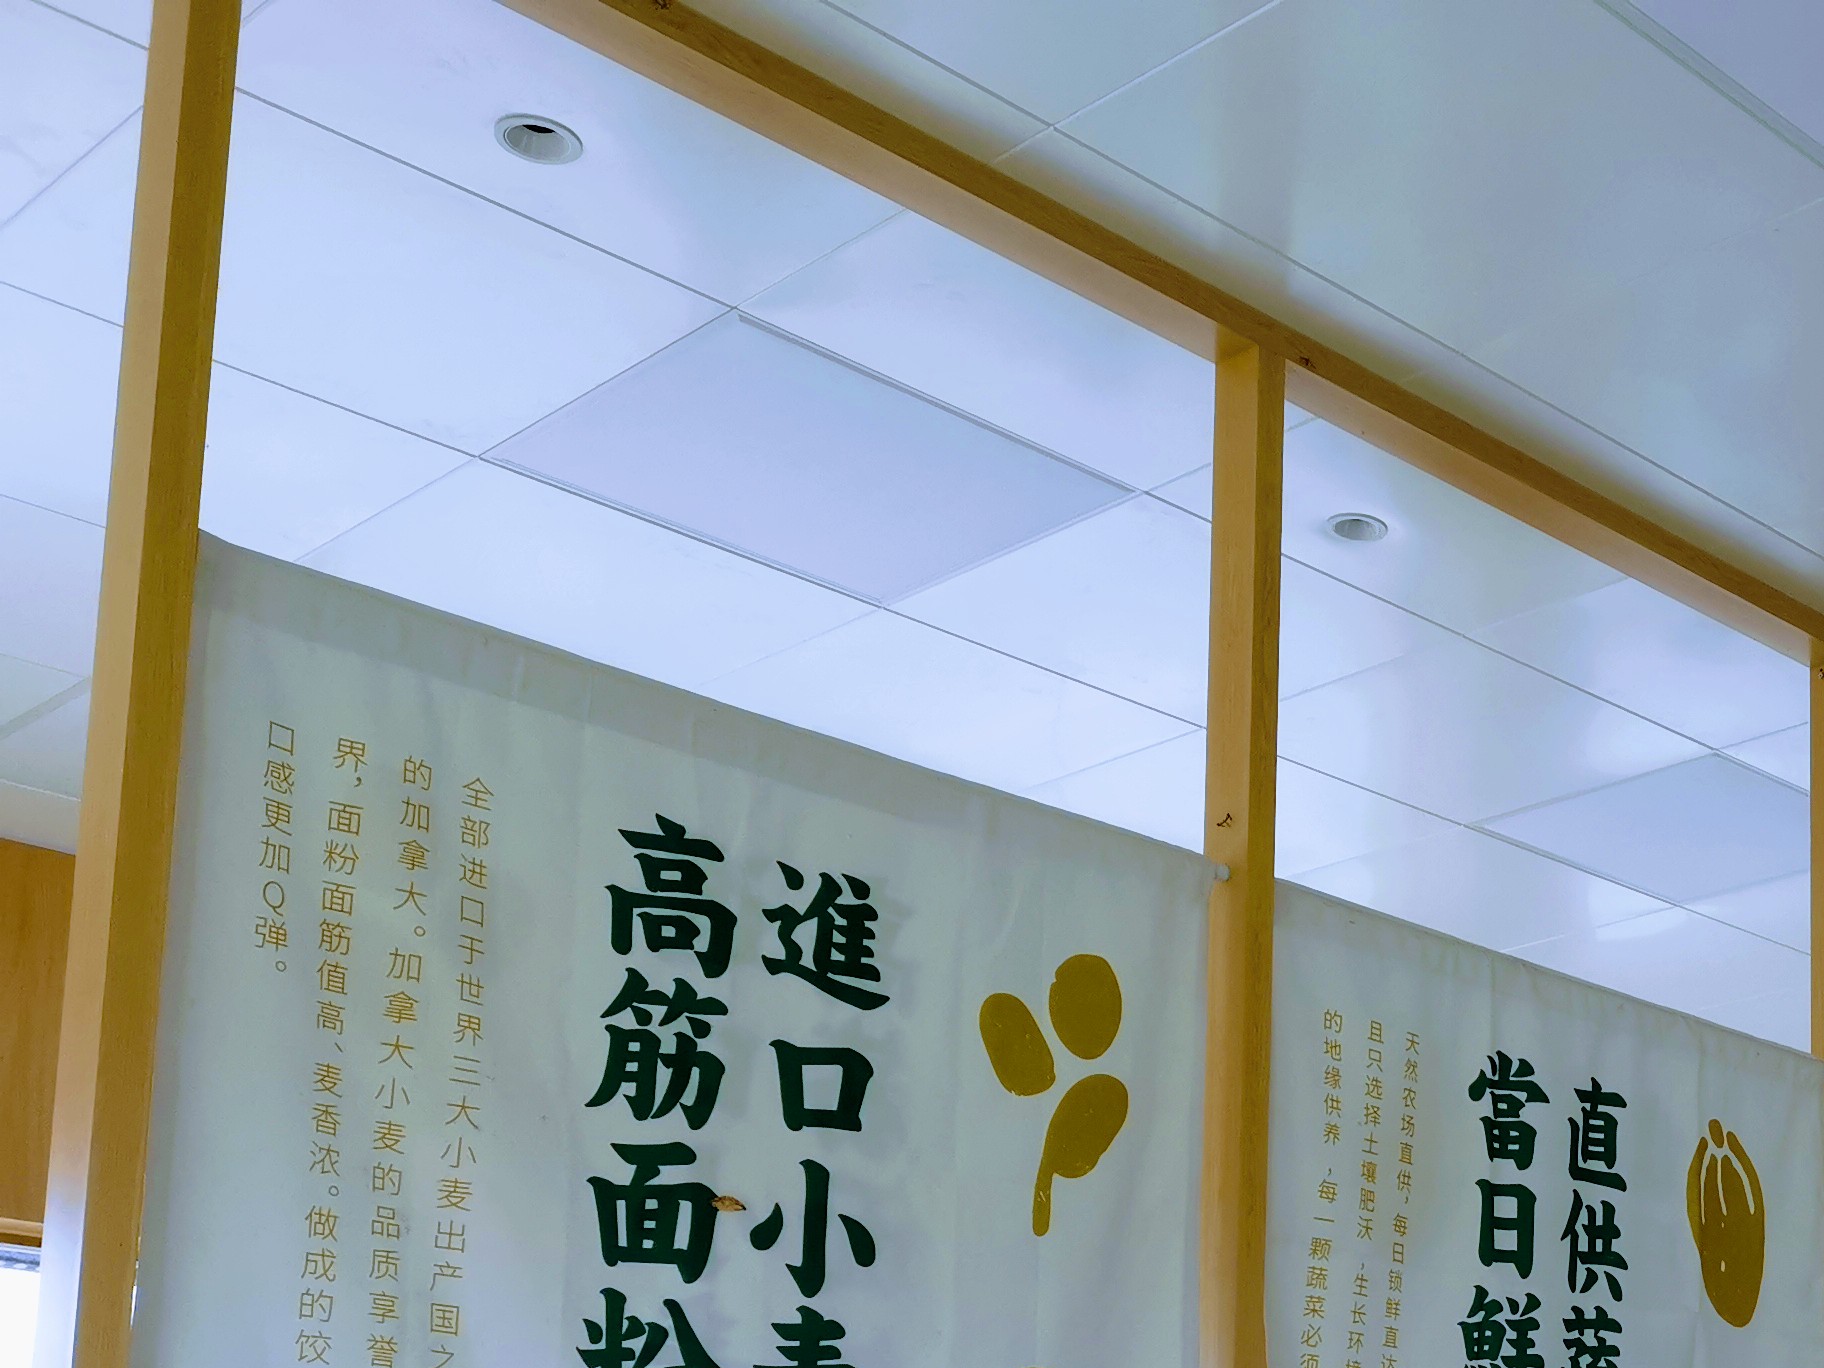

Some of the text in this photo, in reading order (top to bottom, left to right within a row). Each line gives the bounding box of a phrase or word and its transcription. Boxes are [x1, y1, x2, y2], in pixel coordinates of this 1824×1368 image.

[253, 720, 296, 973] 口感更加Q弹。
